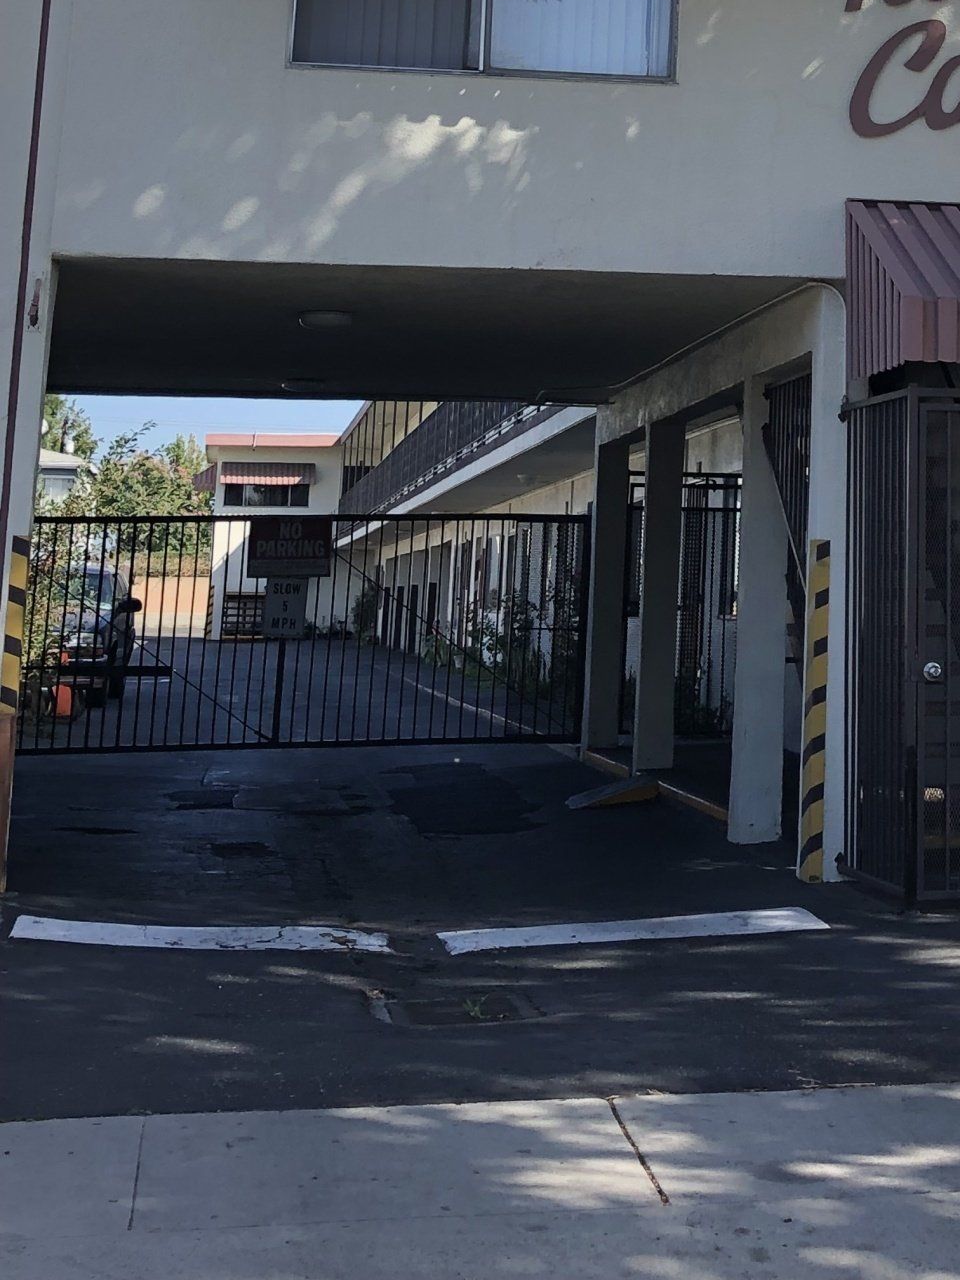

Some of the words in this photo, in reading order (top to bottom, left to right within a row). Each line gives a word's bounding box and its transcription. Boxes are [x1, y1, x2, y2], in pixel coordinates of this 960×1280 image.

[279, 522, 302, 539] NO
[256, 540, 325, 557] PARKING
[273, 582, 302, 595] SLOW
[282, 600, 288, 612] 5
[271, 617, 297, 629] MPH
